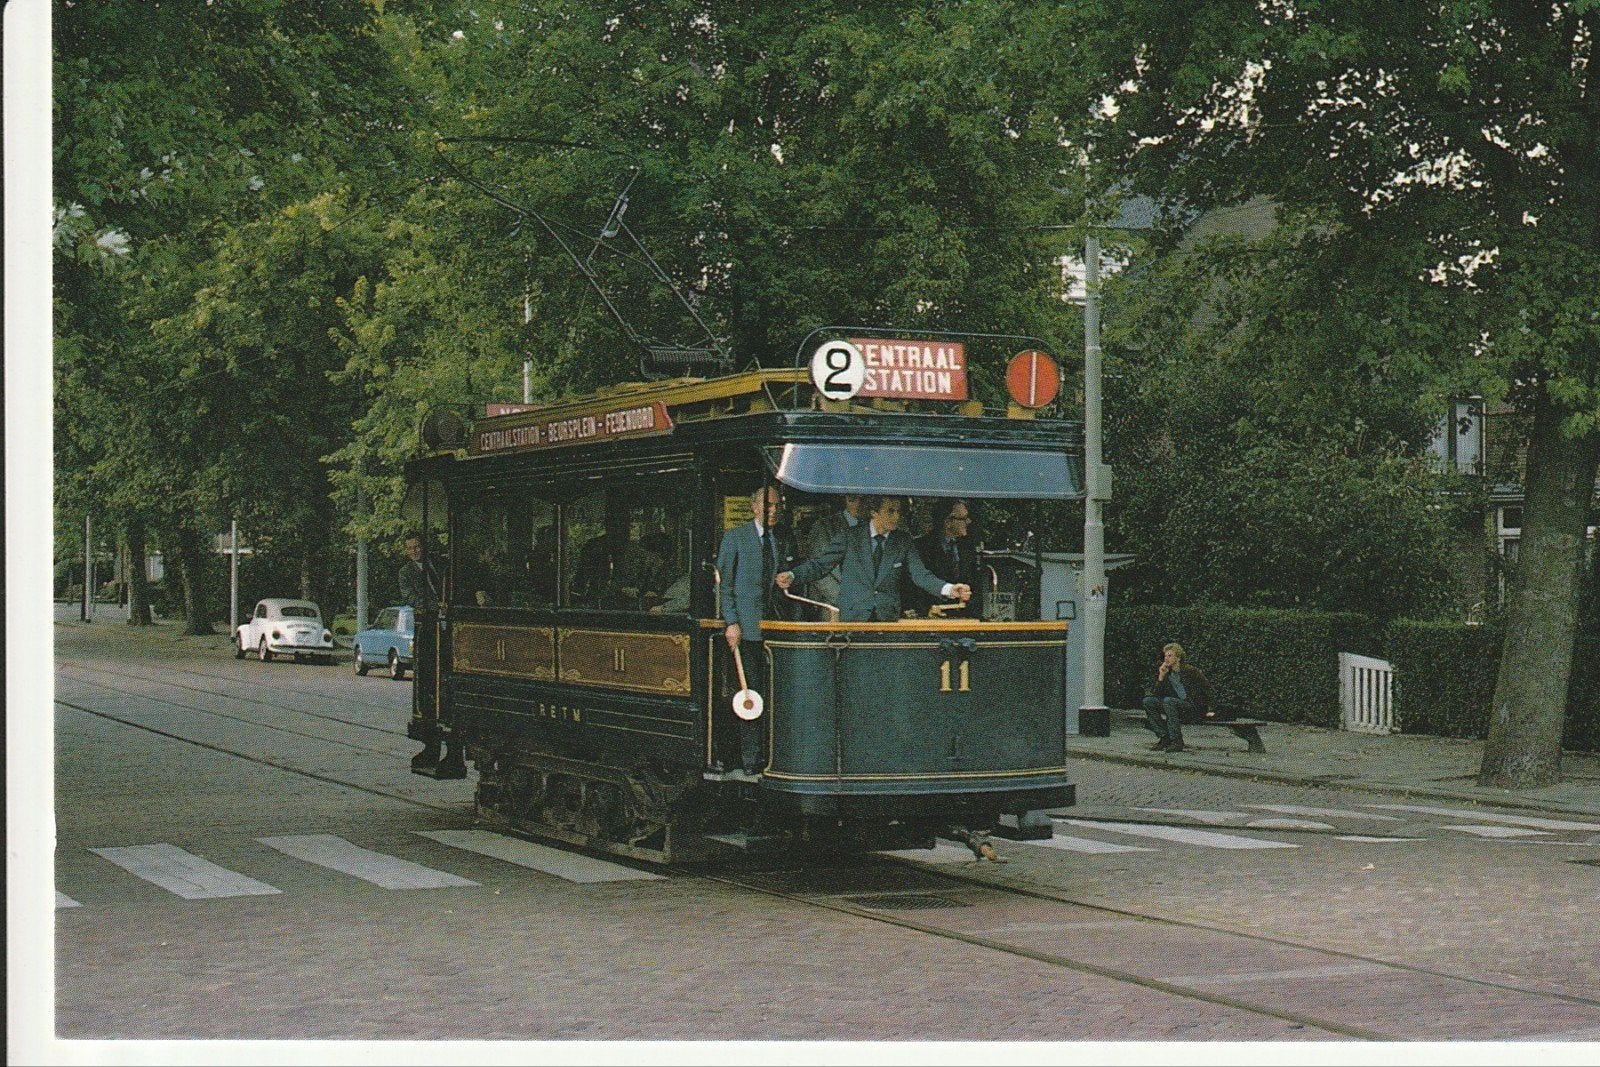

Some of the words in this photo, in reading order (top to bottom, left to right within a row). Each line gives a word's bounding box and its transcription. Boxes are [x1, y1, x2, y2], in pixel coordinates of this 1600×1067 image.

[825, 348, 852, 392] 2
[864, 369, 951, 393] STATION
[939, 660, 971, 692] 11
